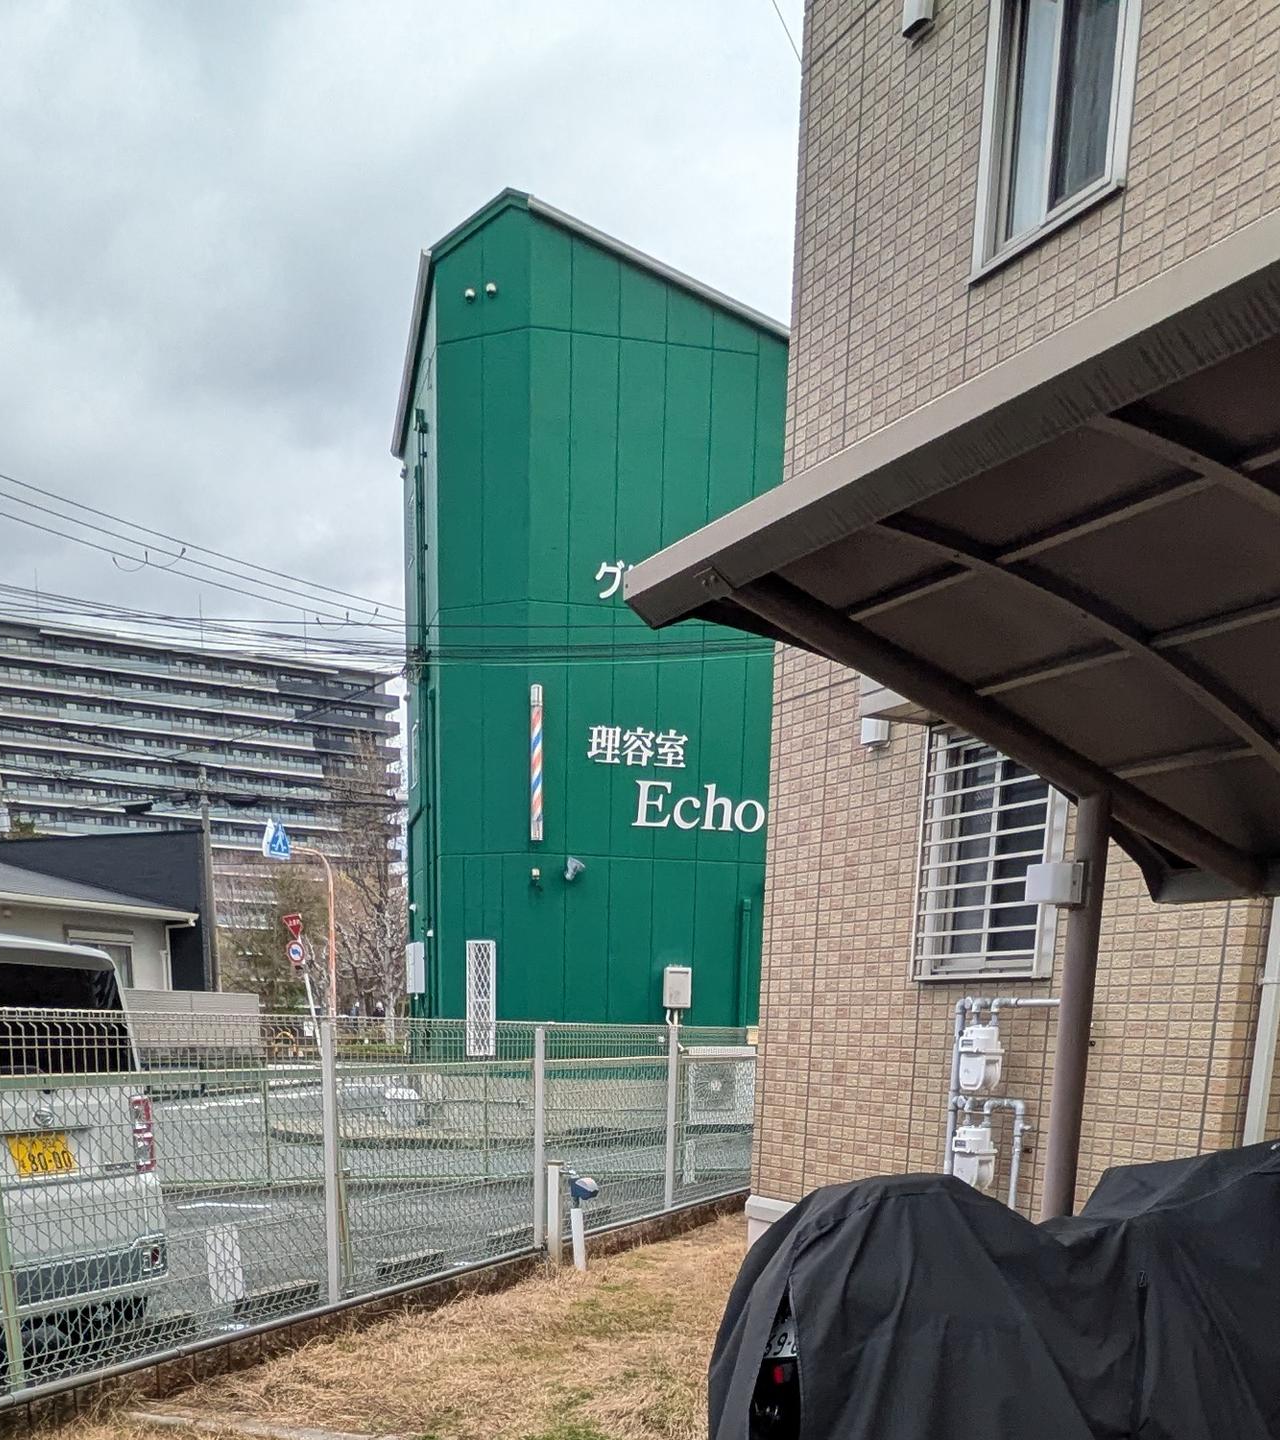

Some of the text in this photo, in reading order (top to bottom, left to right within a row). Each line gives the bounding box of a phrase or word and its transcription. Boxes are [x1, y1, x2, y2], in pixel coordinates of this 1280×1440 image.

[595, 560, 633, 599] グ
[587, 725, 688, 768] 理容室
[631, 780, 766, 833] Echo
